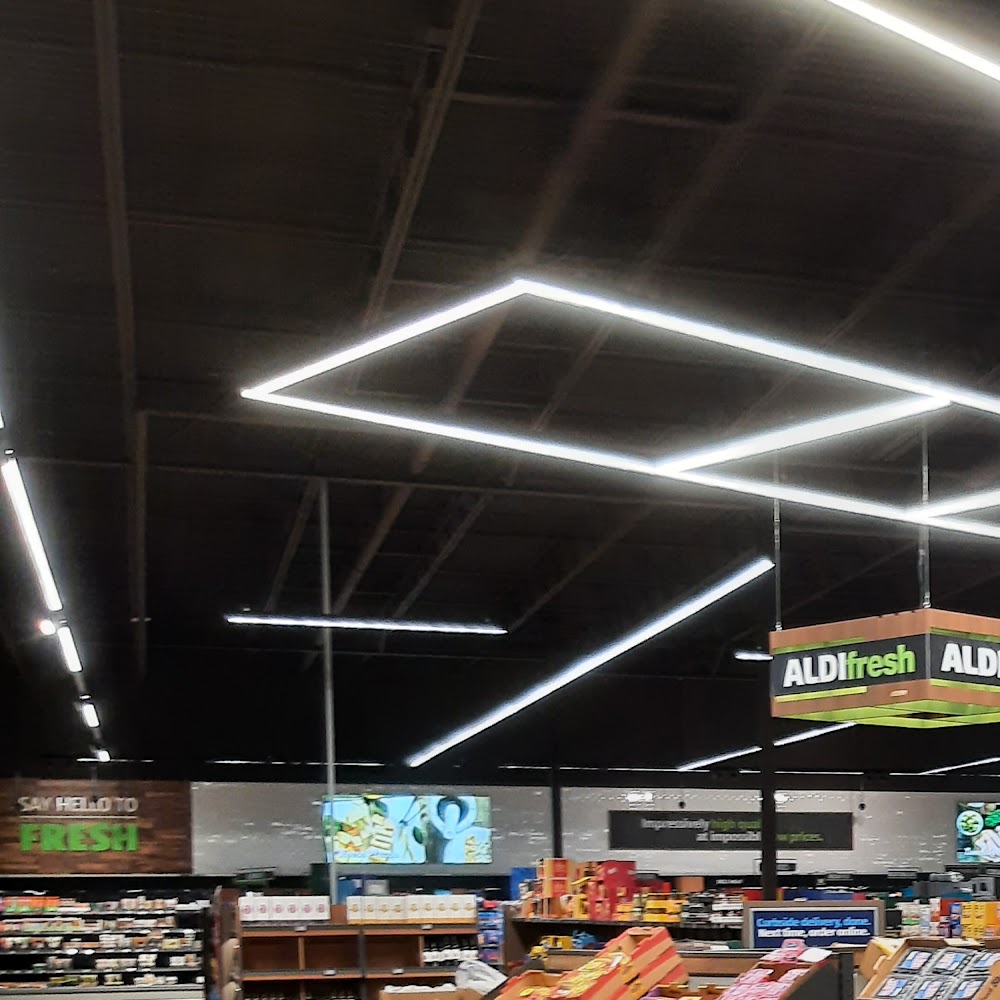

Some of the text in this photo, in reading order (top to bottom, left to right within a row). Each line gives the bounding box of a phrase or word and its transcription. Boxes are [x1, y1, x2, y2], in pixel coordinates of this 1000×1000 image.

[783, 643, 916, 687] ALDIfresh
[18, 796, 51, 812] SAY
[116, 797, 139, 812] TO
[20, 824, 138, 852] FRESH
[710, 830, 762, 844] impossibl
